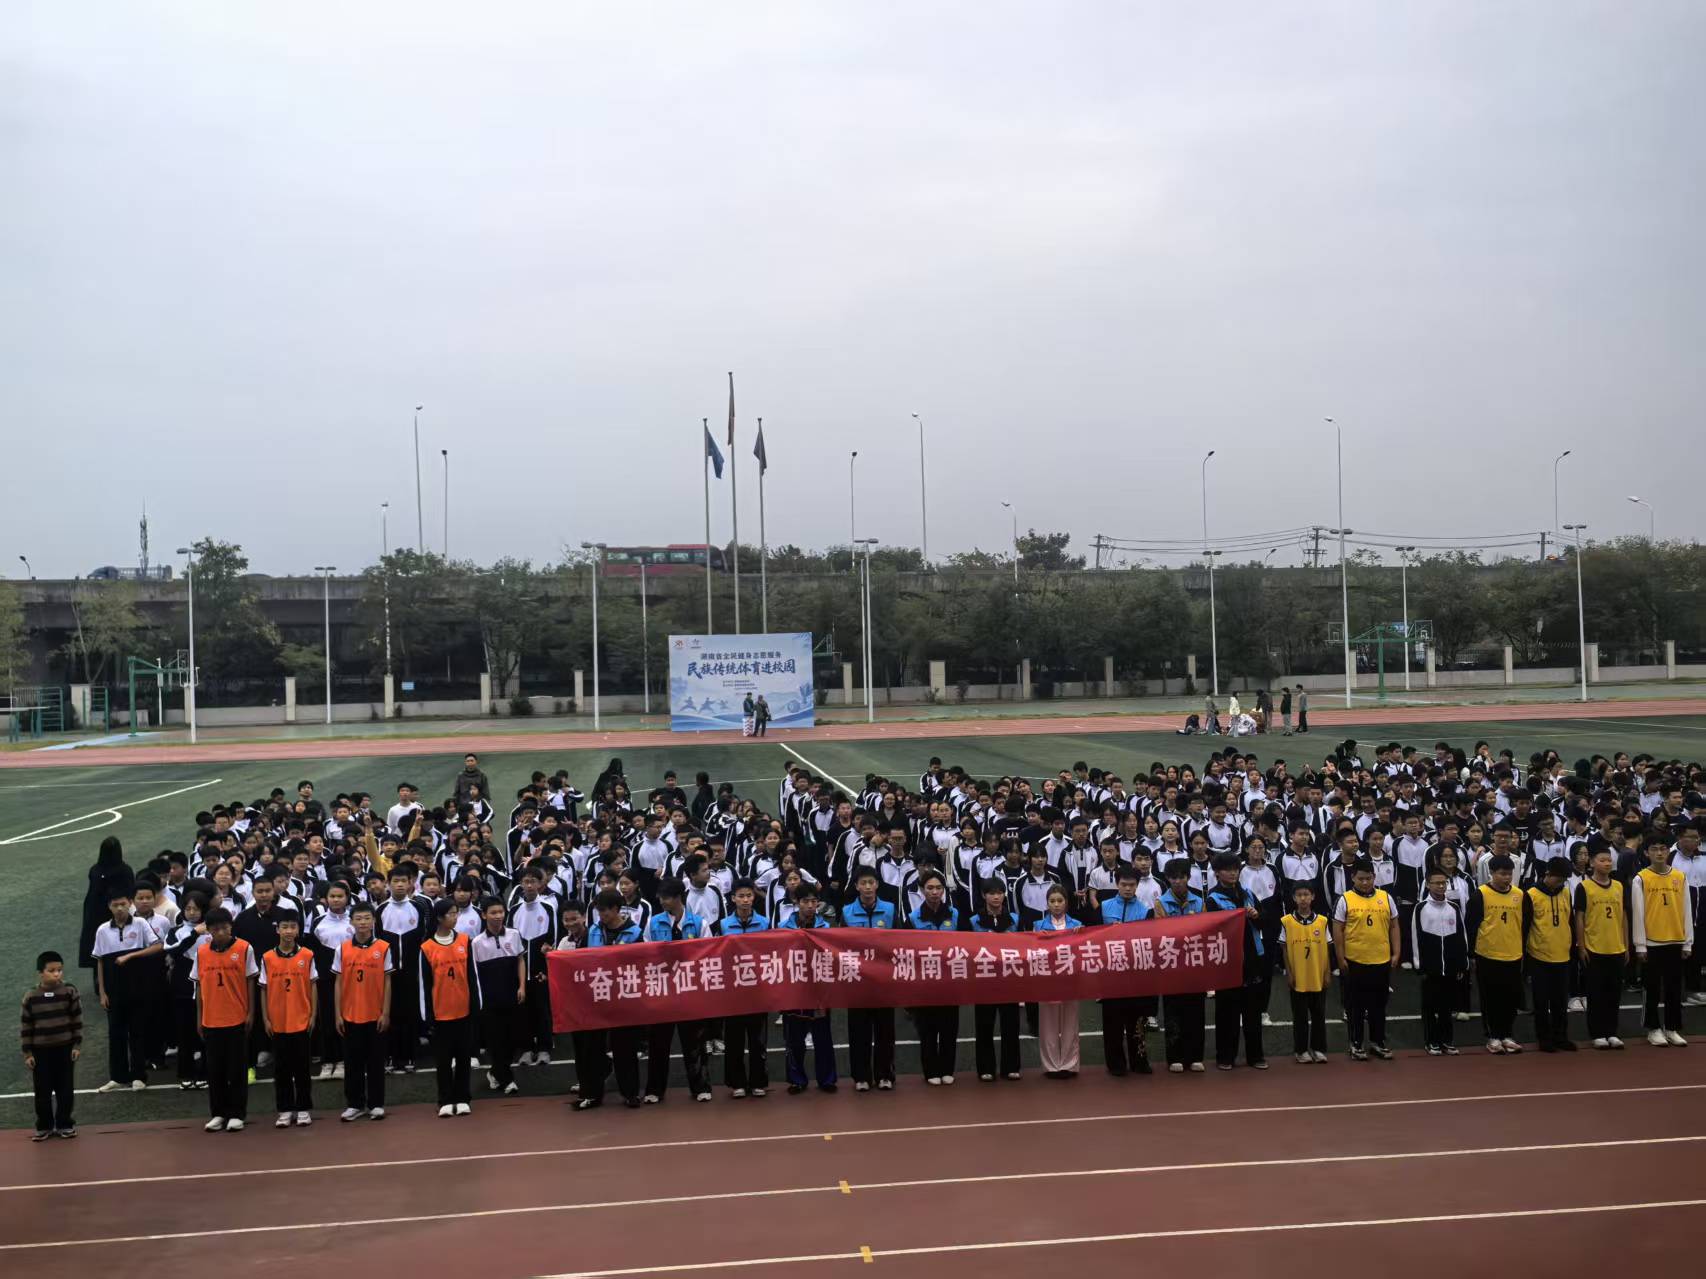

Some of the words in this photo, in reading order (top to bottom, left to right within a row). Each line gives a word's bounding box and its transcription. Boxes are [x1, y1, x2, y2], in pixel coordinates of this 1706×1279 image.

[688, 658, 796, 680] 民族传统体育进校园
[1661, 893, 1668, 906] 1
[1500, 911, 1507, 924] 4
[1605, 906, 1612, 919] 2
[1366, 914, 1373, 927] 6
[1304, 946, 1311, 960] 7
[447, 966, 455, 980] 4
[574, 956, 725, 1002] “奋进新征程
[732, 948, 876, 987] 运动促健康”
[892, 932, 1229, 982] 湖南省全民健身志愿服务活动
[217, 972, 224, 987] 1
[356, 969, 363, 982] 3
